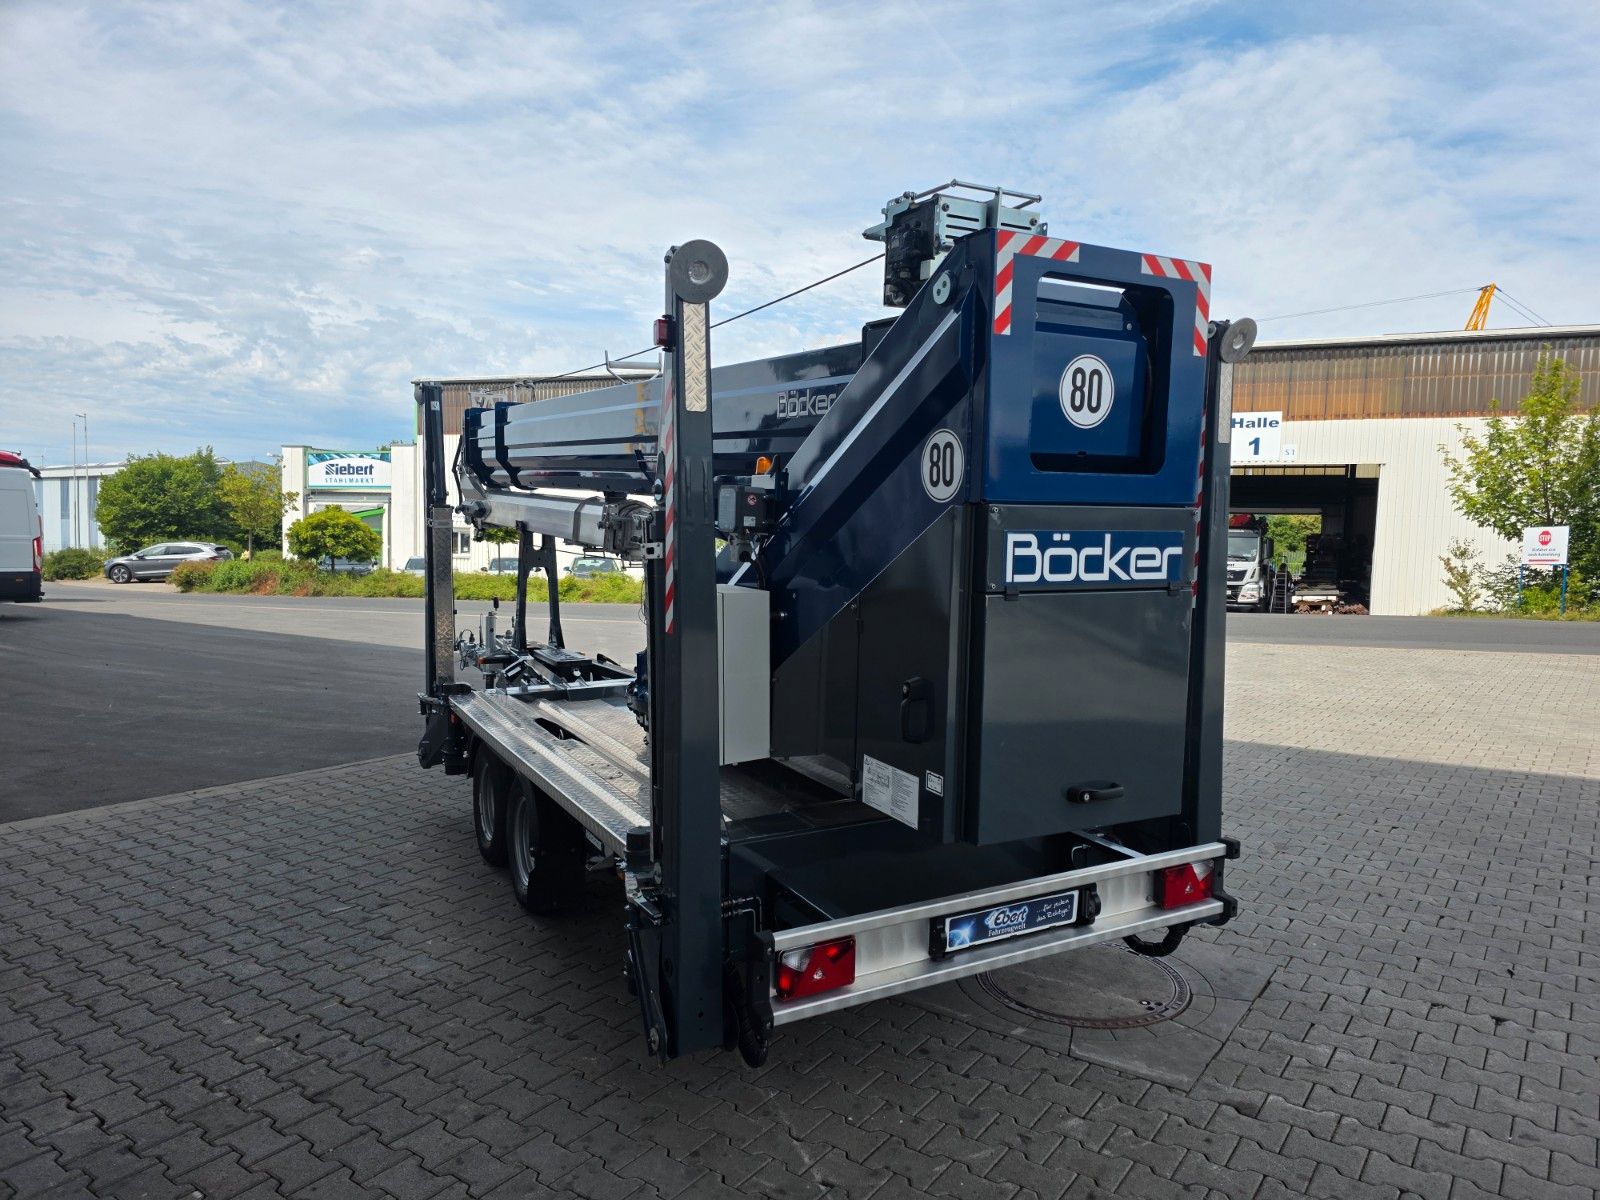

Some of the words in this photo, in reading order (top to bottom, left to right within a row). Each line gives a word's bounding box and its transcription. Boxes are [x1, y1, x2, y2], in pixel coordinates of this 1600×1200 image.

[1070, 366, 1103, 414] 80
[776, 388, 837, 419] Böcker
[1231, 417, 1280, 428] Halle
[1248, 437, 1261, 455] 1
[929, 441, 955, 488] 80
[1005, 532, 1183, 583] Böcker
[988, 922, 1027, 937] Fahrzeugwelt
[994, 906, 1028, 927] Ebert
